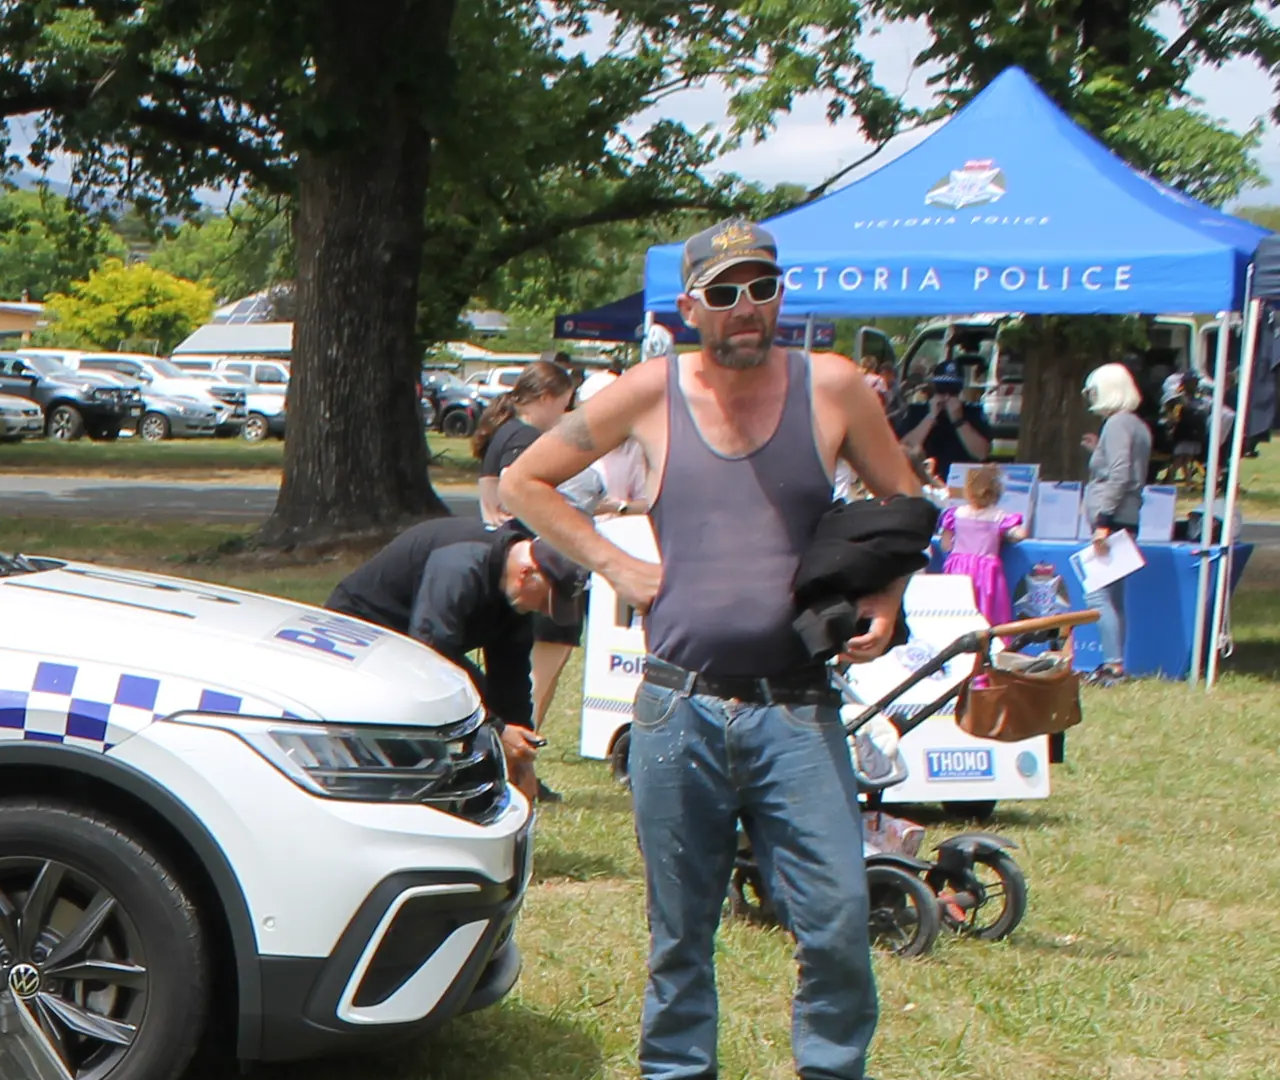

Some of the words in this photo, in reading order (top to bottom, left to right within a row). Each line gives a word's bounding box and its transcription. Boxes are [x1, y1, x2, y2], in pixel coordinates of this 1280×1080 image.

[853, 216, 956, 230] VICTORIA
[970, 215, 1051, 226] POLICE
[784, 266, 941, 292] CTORIA
[973, 265, 1133, 292] POLICE
[610, 654, 647, 674] Poli
[929, 751, 989, 772] THOMO
